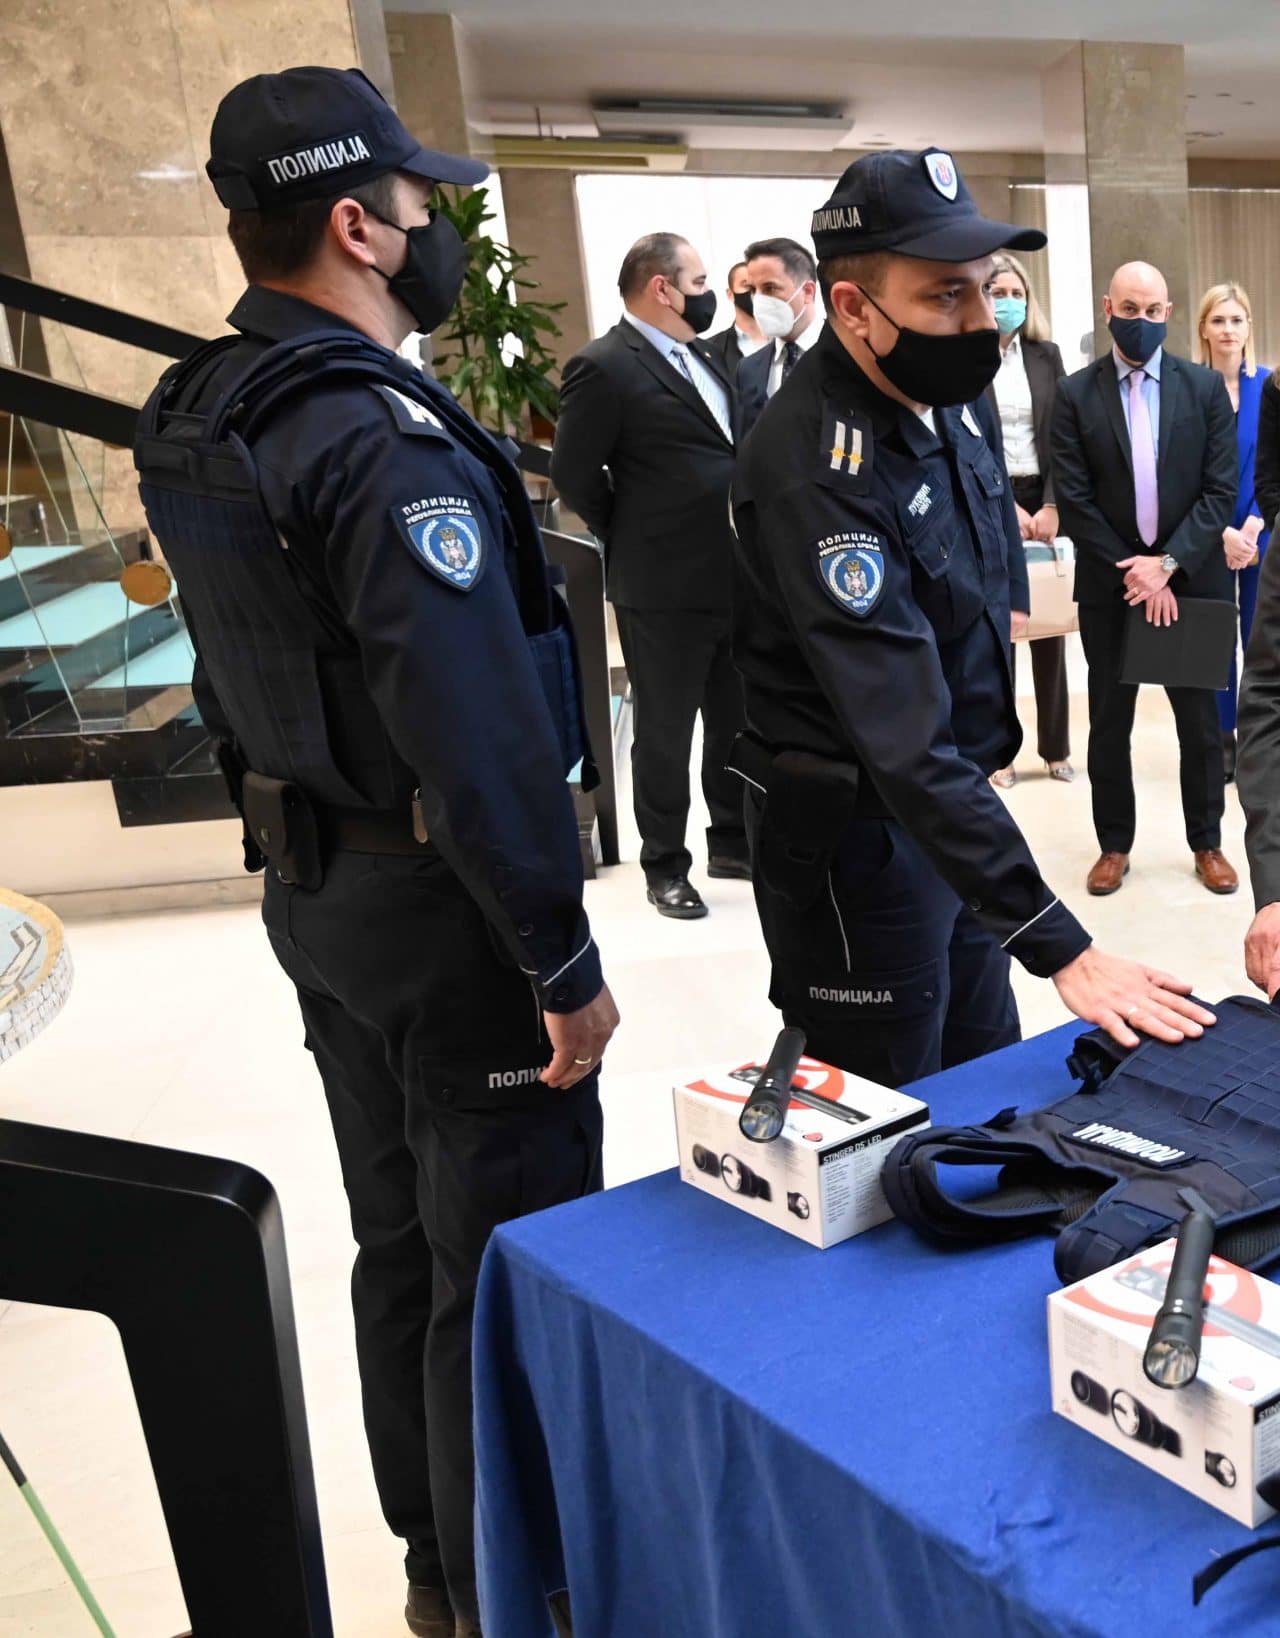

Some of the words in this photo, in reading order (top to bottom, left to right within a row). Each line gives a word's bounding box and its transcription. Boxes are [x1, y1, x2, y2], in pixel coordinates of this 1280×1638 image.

[267, 135, 371, 184] ПОЛИЦИЈА
[402, 496, 470, 516] ПОЛИЦИЈА
[818, 532, 879, 549] ПОЛИЦИЈА
[809, 986, 893, 1005] ПОЛИЦИЈА
[488, 1066, 544, 1089] ПОЛИ
[823, 1145, 855, 1164] STINGER
[867, 1134, 882, 1147] LED
[1072, 1122, 1186, 1163] ПОЛИЦИЈА
